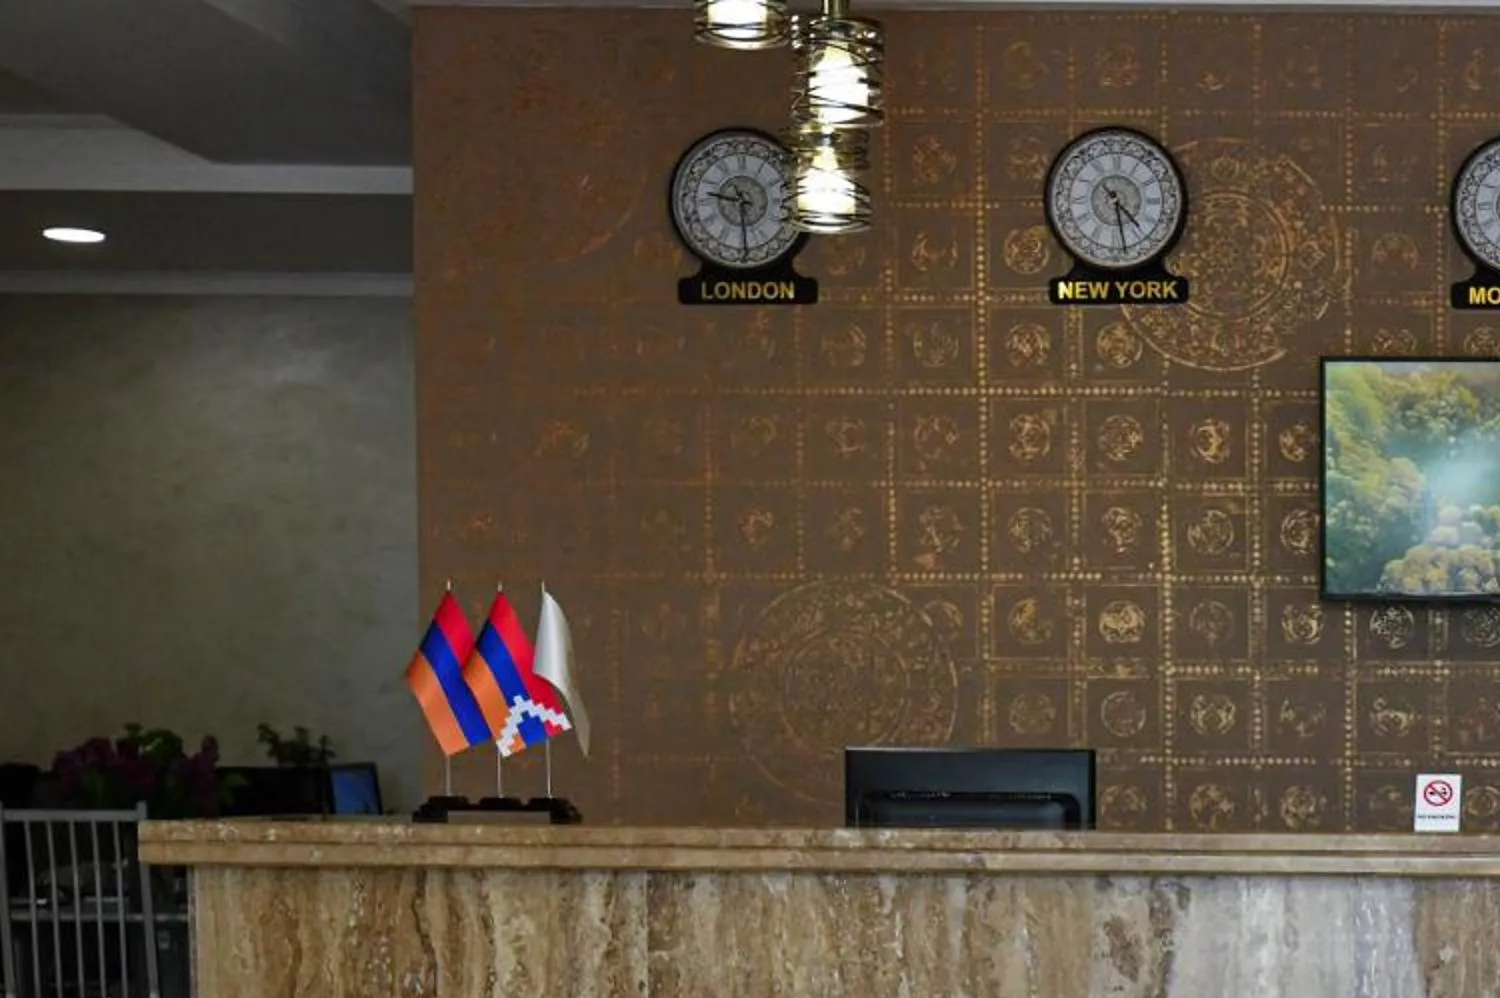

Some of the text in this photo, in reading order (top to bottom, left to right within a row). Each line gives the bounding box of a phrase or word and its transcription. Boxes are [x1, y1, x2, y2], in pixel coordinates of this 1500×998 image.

[701, 281, 795, 299] LONDON
[1057, 281, 1178, 299] NEW YORK
